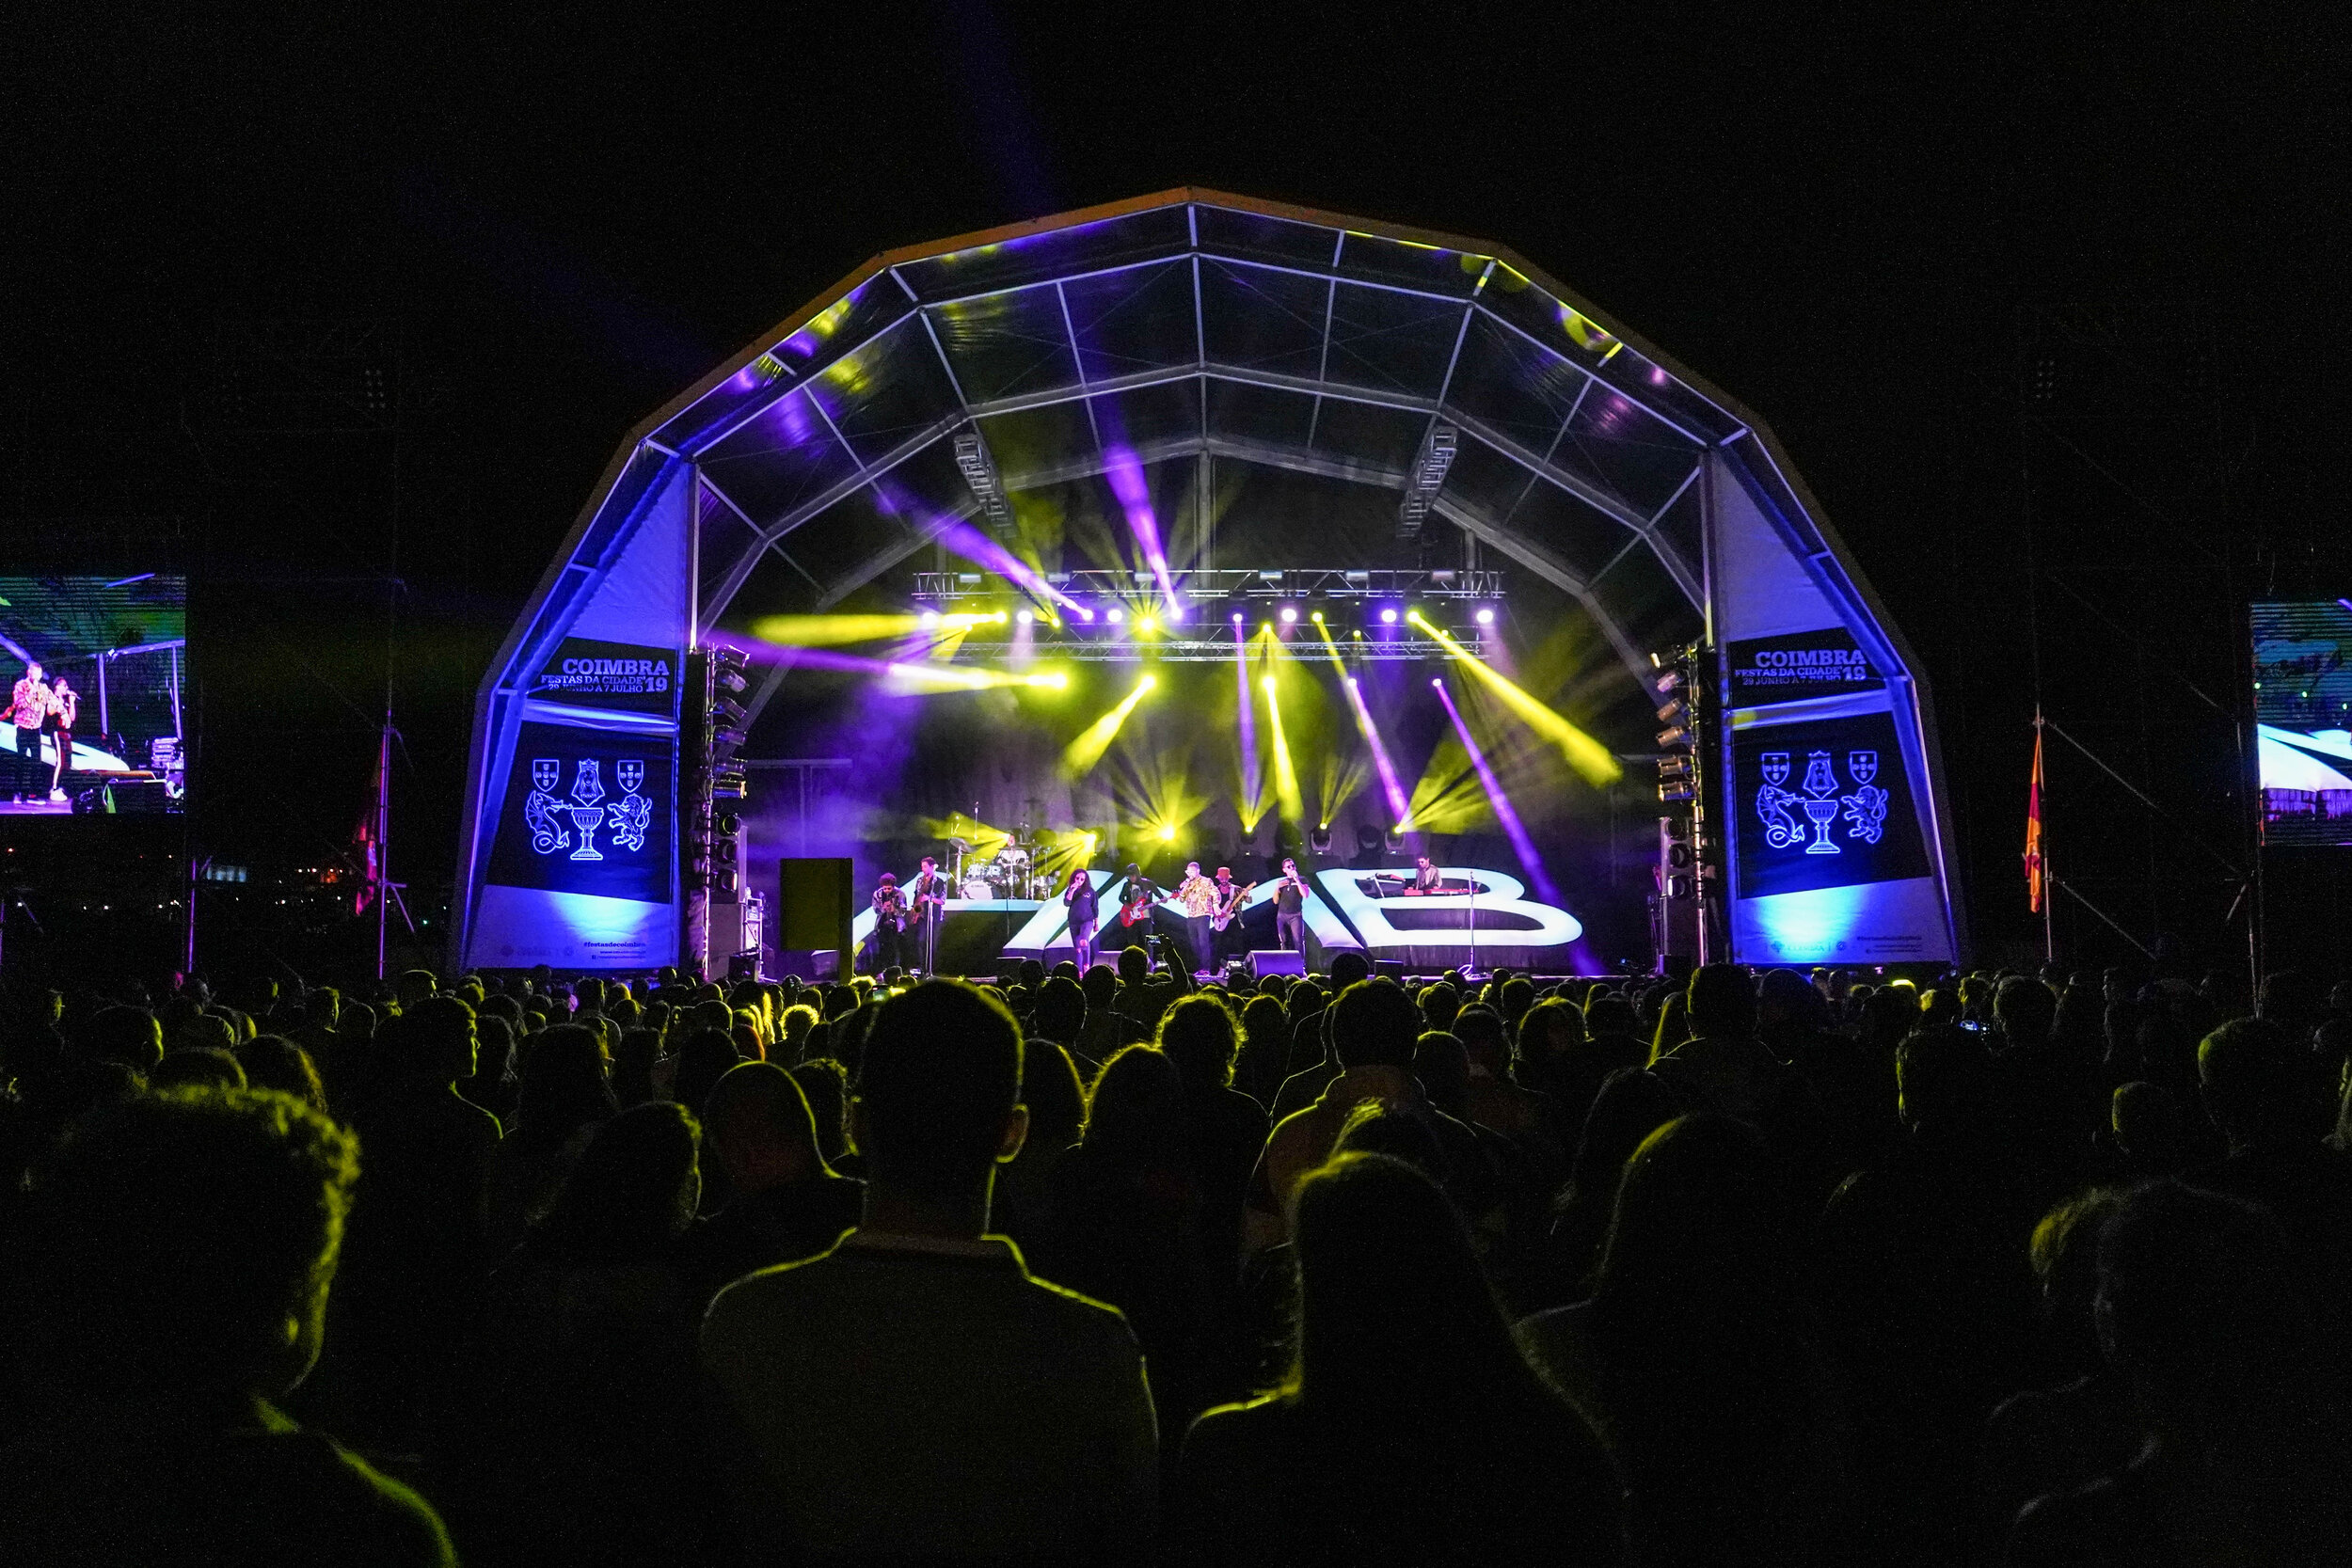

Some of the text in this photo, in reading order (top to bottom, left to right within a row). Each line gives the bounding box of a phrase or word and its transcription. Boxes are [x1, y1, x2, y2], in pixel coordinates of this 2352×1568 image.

[1755, 649, 1867, 668] COIMBRA
[562, 658, 670, 676] COIMBRA
[1734, 666, 1840, 677] FESTAS DA CIDADE
[540, 674, 644, 685] FESTAS DA CIDADE
[1755, 676, 1789, 686] JUNHO
[1791, 676, 1800, 685] A
[562, 684, 595, 692] JUNHO
[595, 684, 603, 692] A
[603, 685, 610, 693] 7
[611, 685, 644, 693] JULHO
